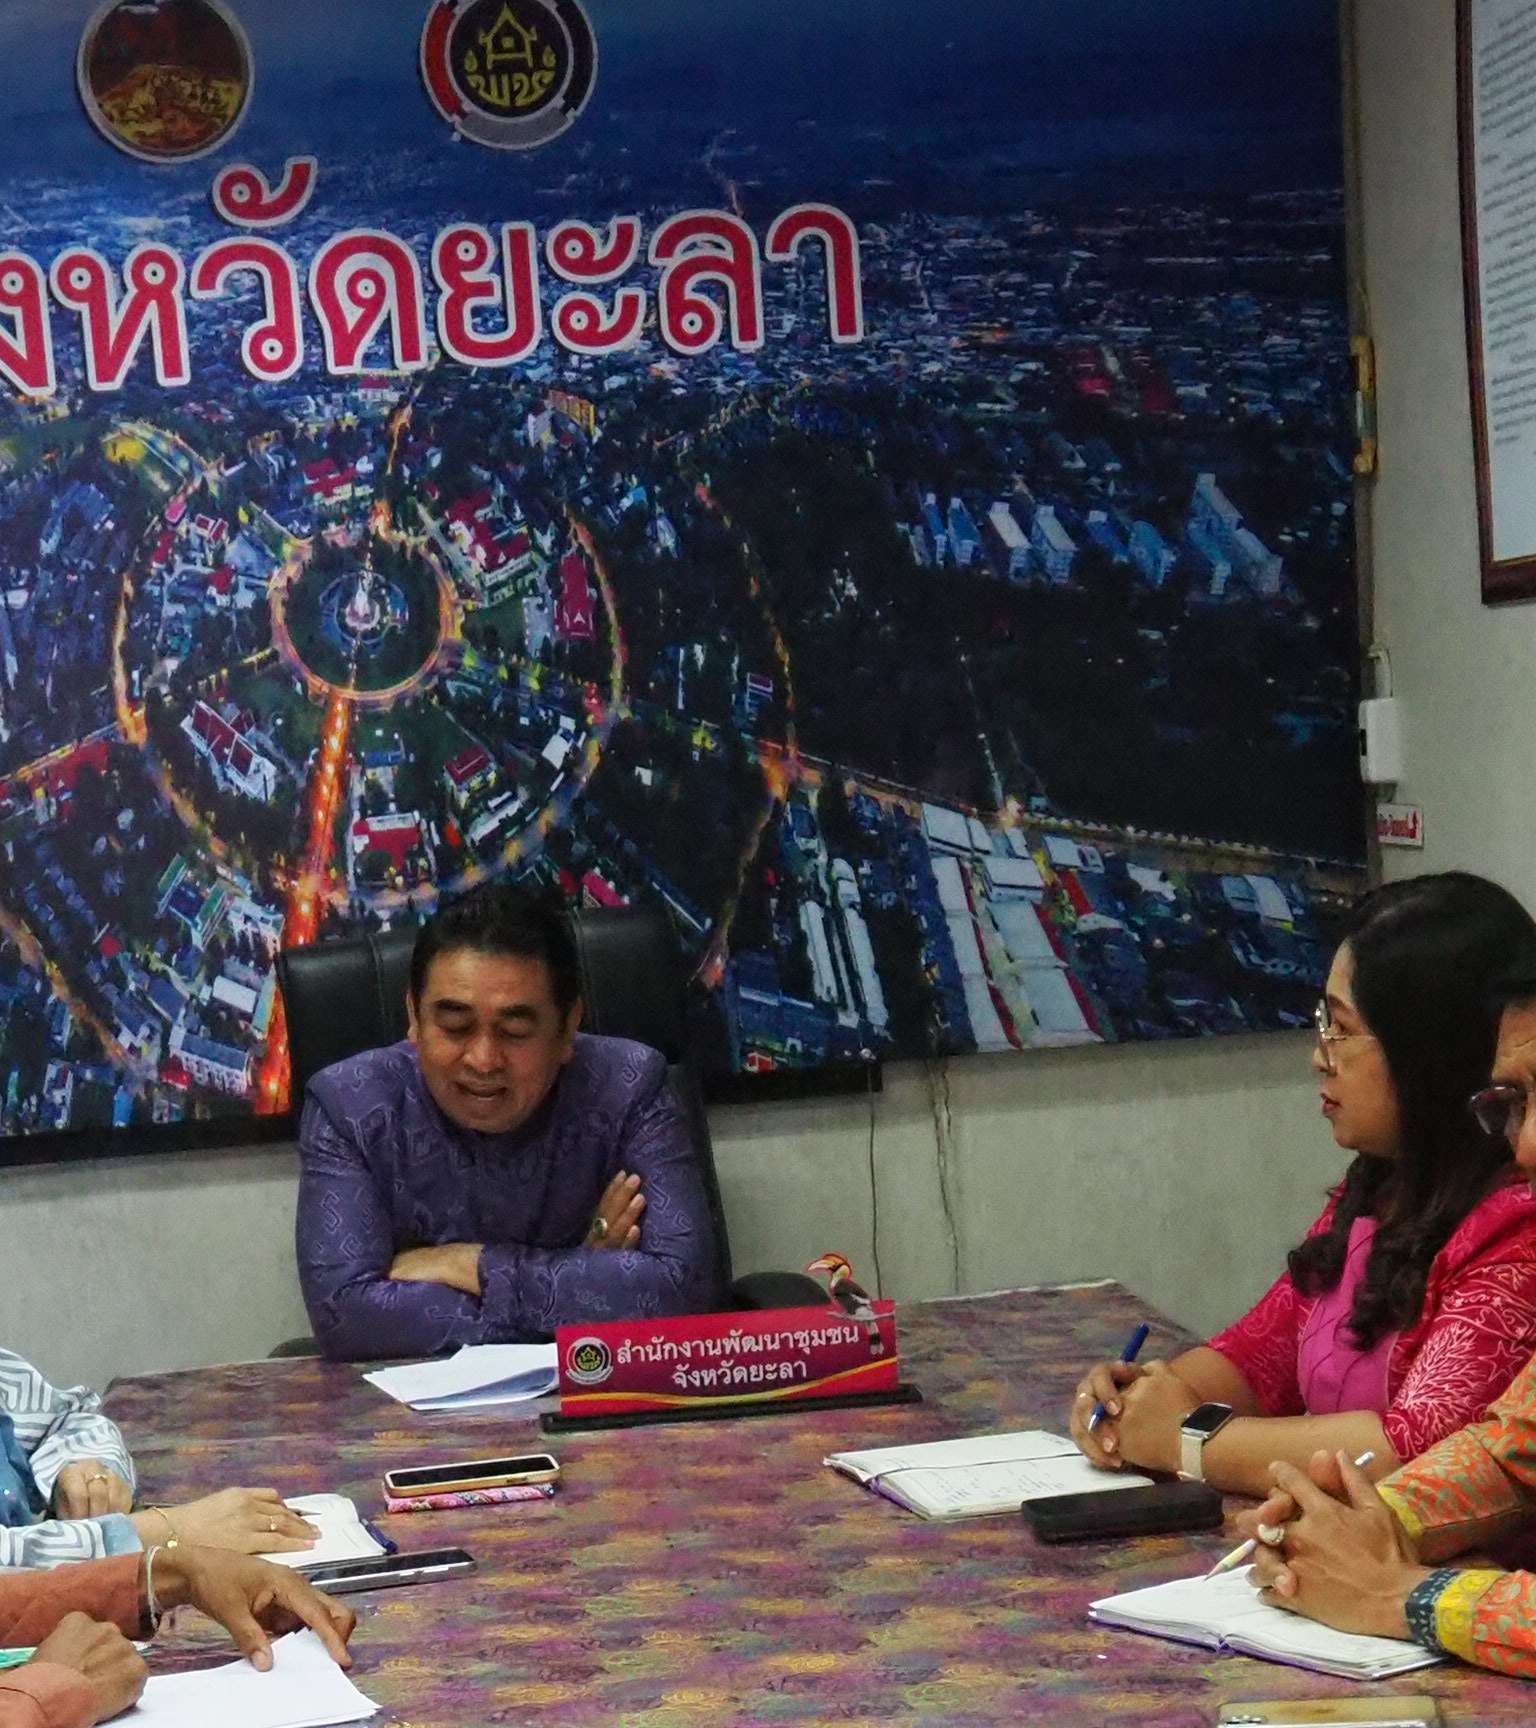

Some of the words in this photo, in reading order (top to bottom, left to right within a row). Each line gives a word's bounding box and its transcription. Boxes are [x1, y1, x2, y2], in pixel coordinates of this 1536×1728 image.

[616, 1324, 860, 1365] สำนักงานพัฒนาชุมชน
[671, 1360, 808, 1389] จังหวัดยะลา
